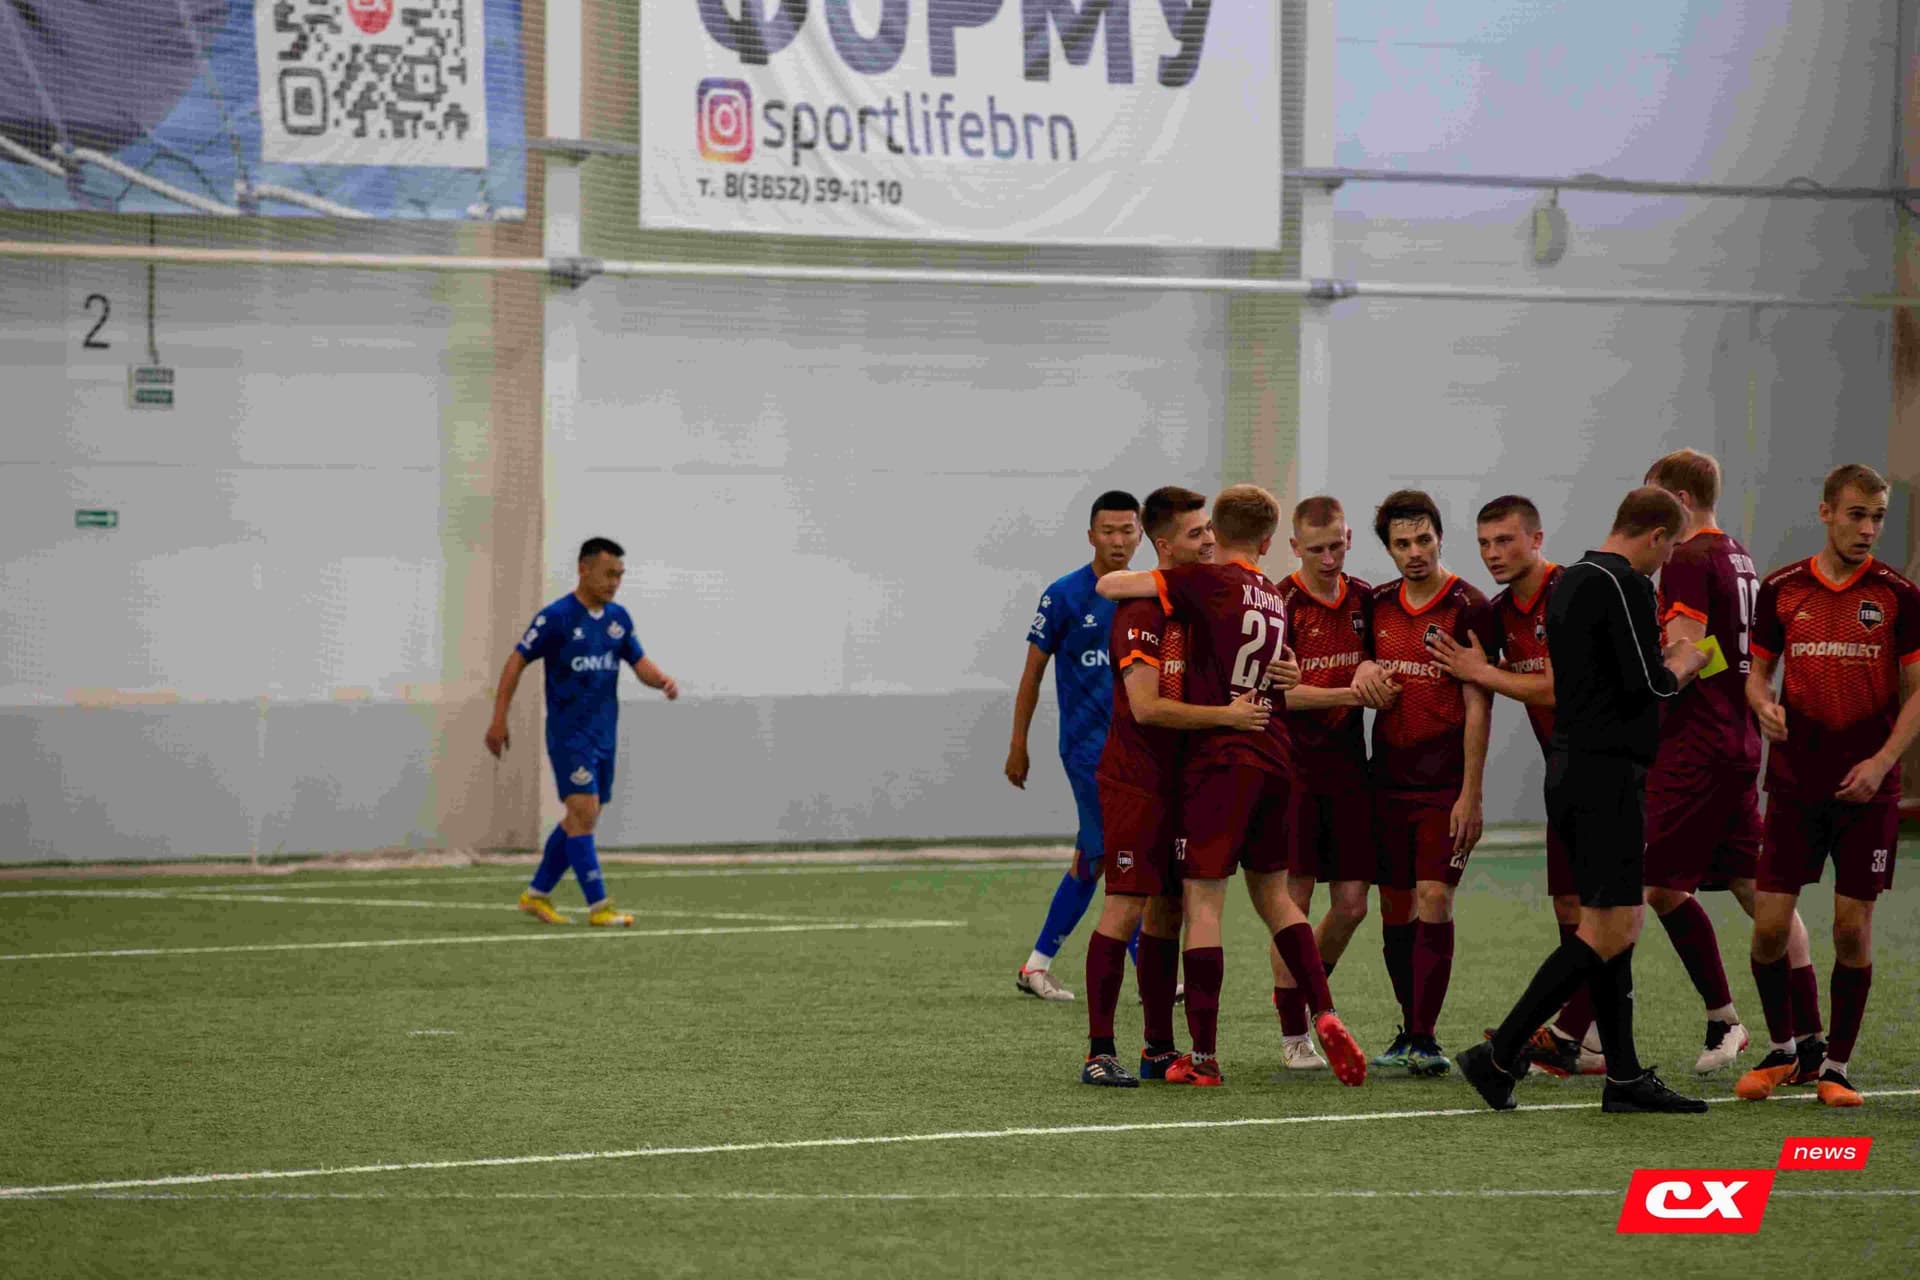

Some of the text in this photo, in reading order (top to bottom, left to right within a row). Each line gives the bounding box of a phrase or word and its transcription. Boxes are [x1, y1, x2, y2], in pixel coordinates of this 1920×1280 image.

[762, 91, 1078, 167] sportlifebrn
[724, 172, 808, 205] 8(3852)
[813, 176, 902, 205] 59-11-10
[84, 293, 110, 349] 2
[1230, 609, 1285, 693] 27
[1791, 641, 1882, 659] ПРОДИНВЕСТ
[1871, 848, 1888, 873] 33
